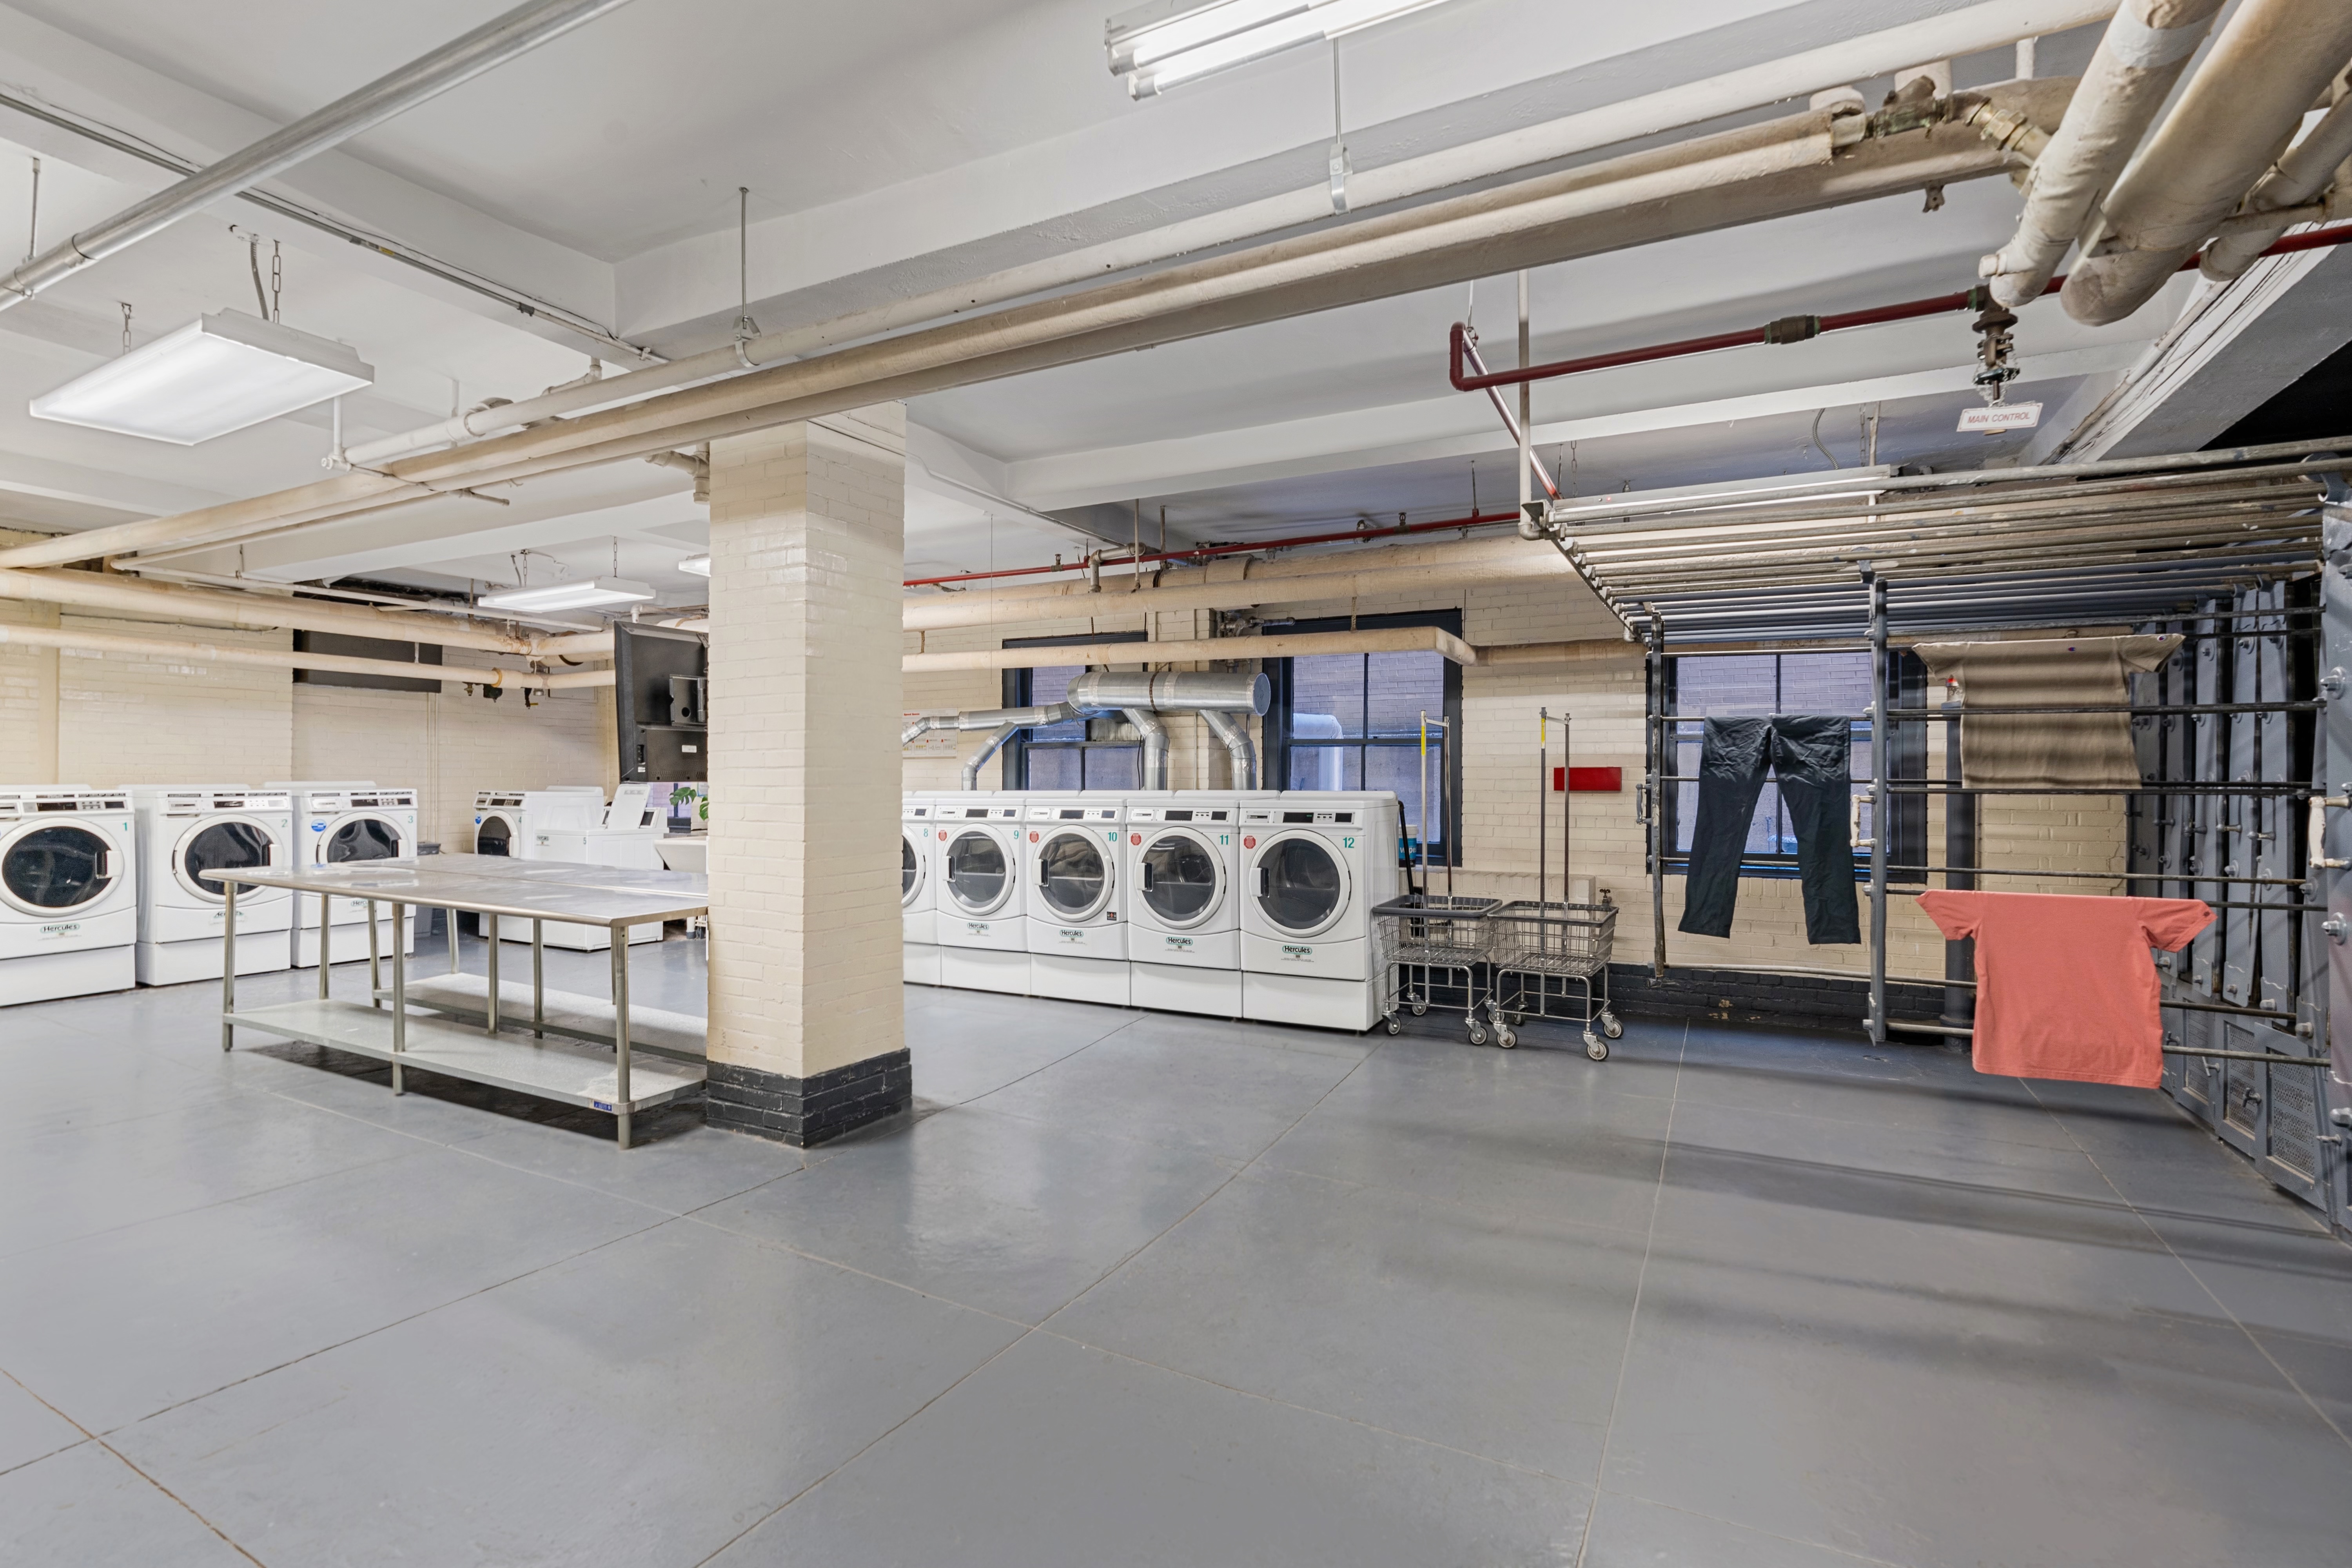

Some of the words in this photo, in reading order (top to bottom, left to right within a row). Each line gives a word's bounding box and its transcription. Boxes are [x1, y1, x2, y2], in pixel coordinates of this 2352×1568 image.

[1968, 415, 1989, 423] MAIN
[1992, 412, 2030, 422] CONTROL
[281, 818, 288, 828] 2
[408, 815, 413, 824] 3
[122, 822, 127, 831] 1
[924, 828, 928, 837] 8
[1014, 830, 1019, 839] 9
[1108, 832, 1117, 842] 10
[1220, 834, 1229, 845] 11
[1343, 837, 1355, 848] 12
[1399, 847, 1417, 855] wpe
